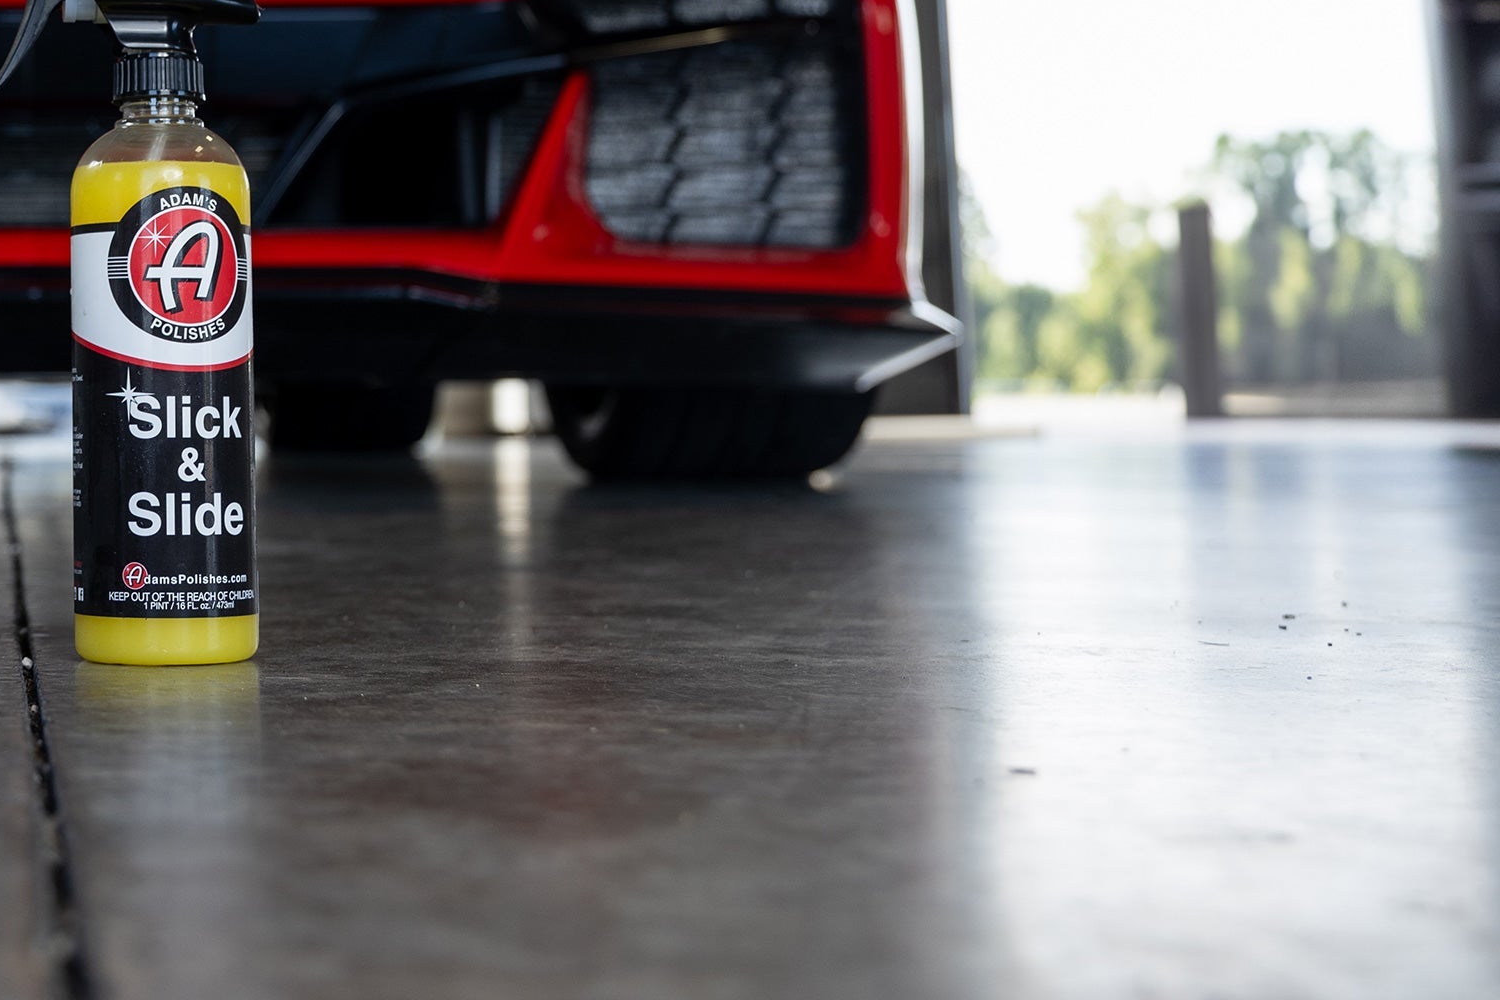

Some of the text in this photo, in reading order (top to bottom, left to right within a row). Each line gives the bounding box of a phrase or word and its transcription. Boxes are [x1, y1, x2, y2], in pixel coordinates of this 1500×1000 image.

[159, 193, 218, 212] ADAM'S
[150, 317, 226, 340] POLISHES
[128, 395, 242, 439] Slick
[177, 446, 207, 482] &
[127, 491, 244, 537] Slide
[109, 591, 130, 601] KEEP
[131, 592, 150, 602] OUT
[151, 592, 165, 602] OF
[166, 592, 185, 602] THE
[186, 591, 217, 602] REACH
[217, 590, 228, 601] OF
[143, 602, 148, 610] 1
[150, 602, 169, 610] PINT
[176, 602, 186, 610] 16
[216, 600, 235, 609] 473ml
